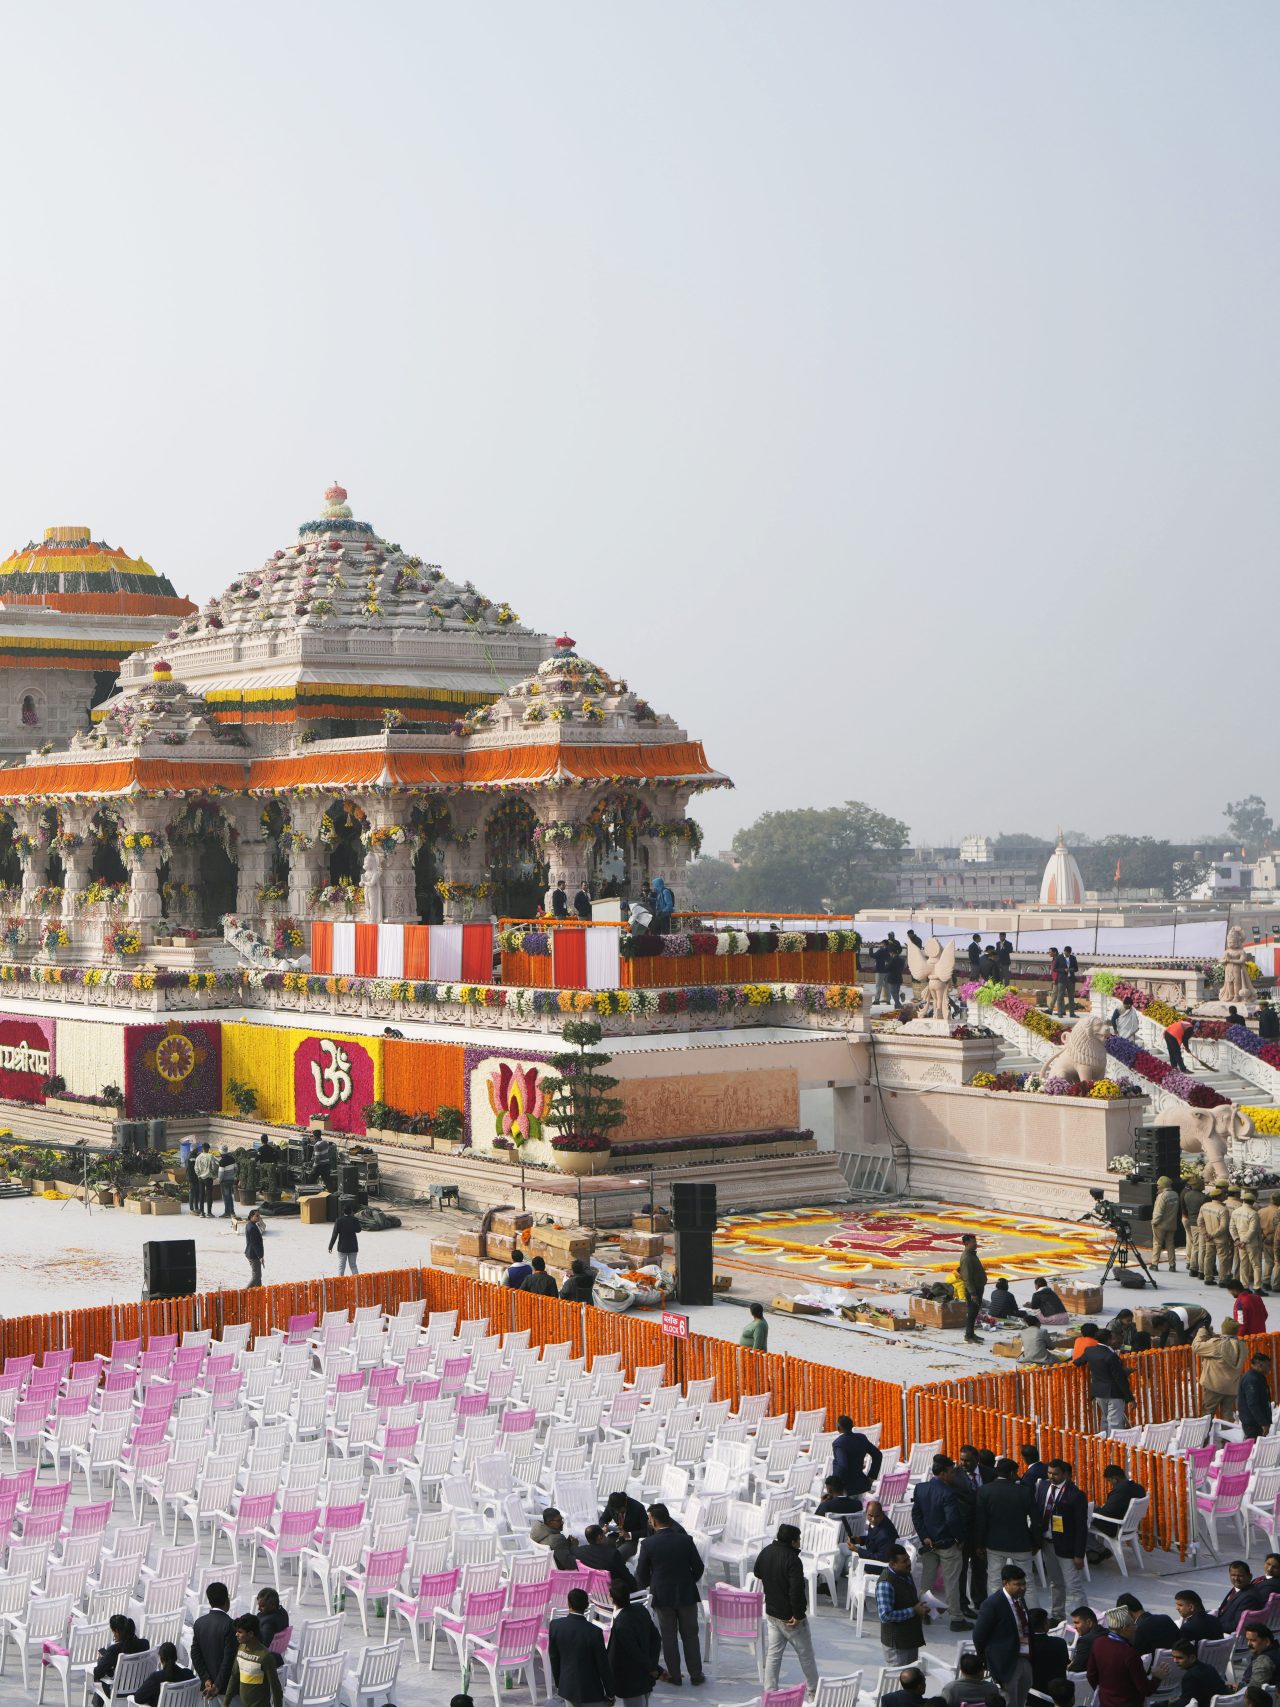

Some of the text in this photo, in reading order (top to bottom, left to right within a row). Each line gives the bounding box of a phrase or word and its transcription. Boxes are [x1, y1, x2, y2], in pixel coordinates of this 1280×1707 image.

[663, 1315, 678, 1325] ब्लॉक
[663, 1320, 685, 1335] BLOCK 6
